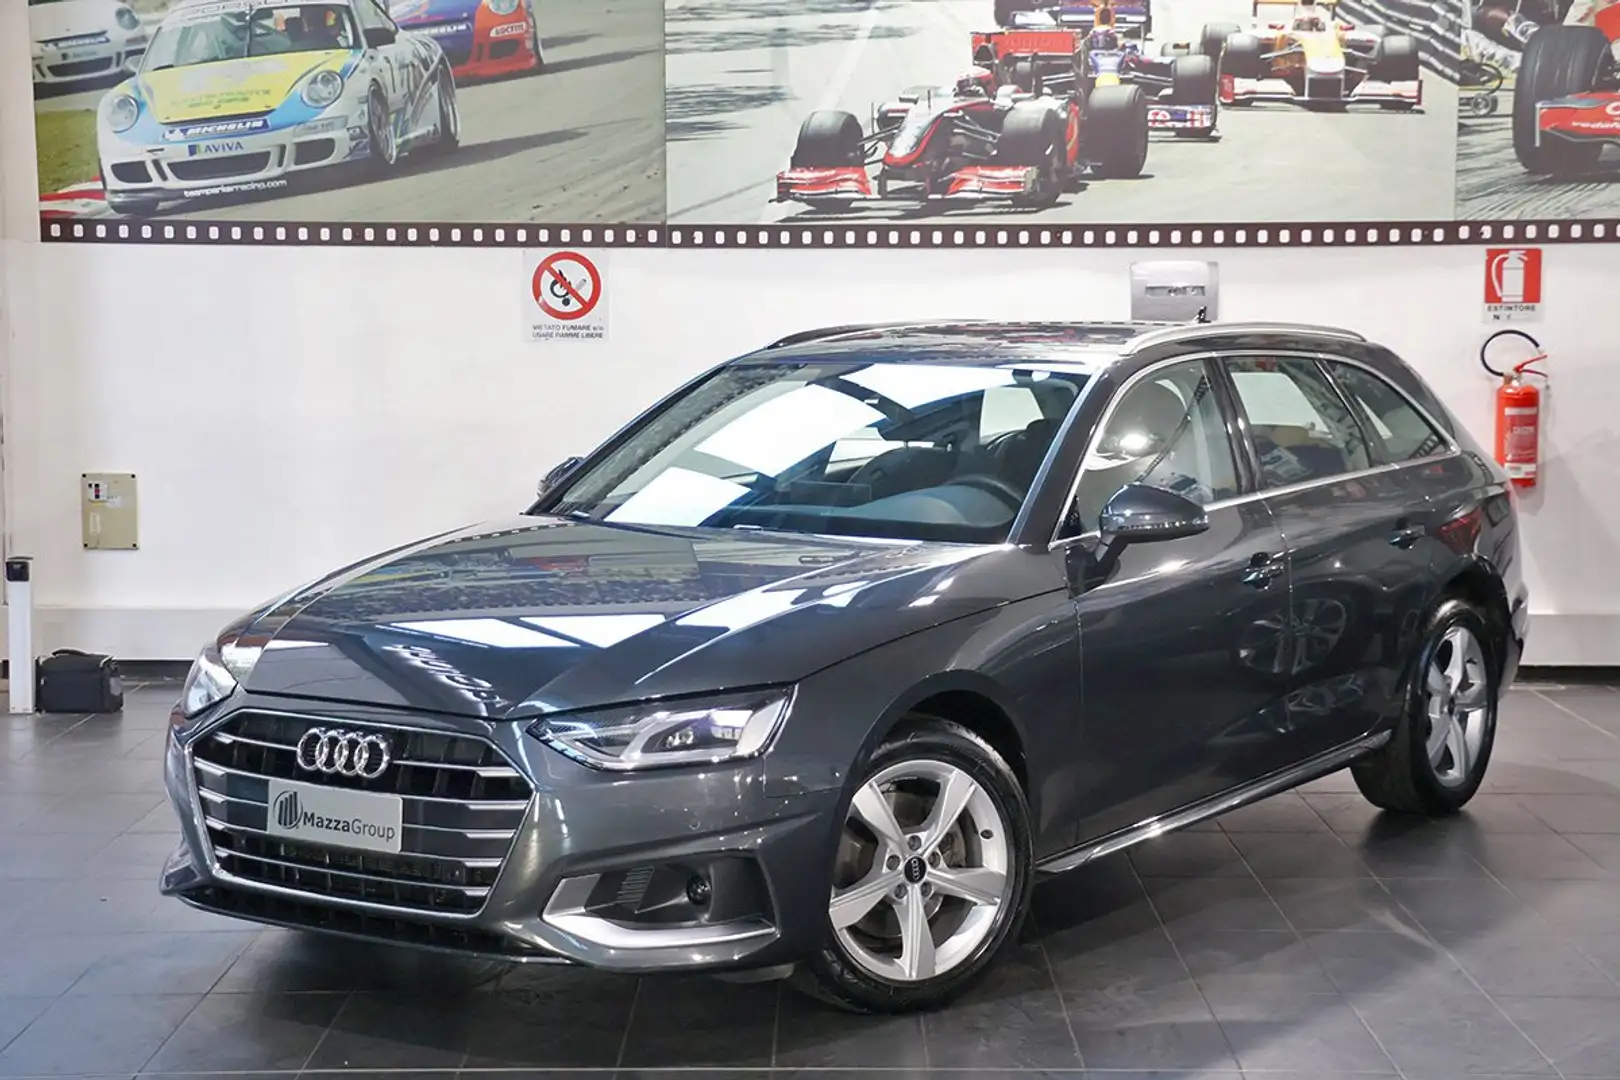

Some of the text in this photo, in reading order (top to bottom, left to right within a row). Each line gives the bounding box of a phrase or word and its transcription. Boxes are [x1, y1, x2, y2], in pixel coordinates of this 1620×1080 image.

[186, 120, 263, 135] MICHELIN
[204, 141, 244, 154] AVIVA
[532, 331, 603, 339] USARE FIAMME LIBERE
[302, 811, 395, 841] MazzaGroup
